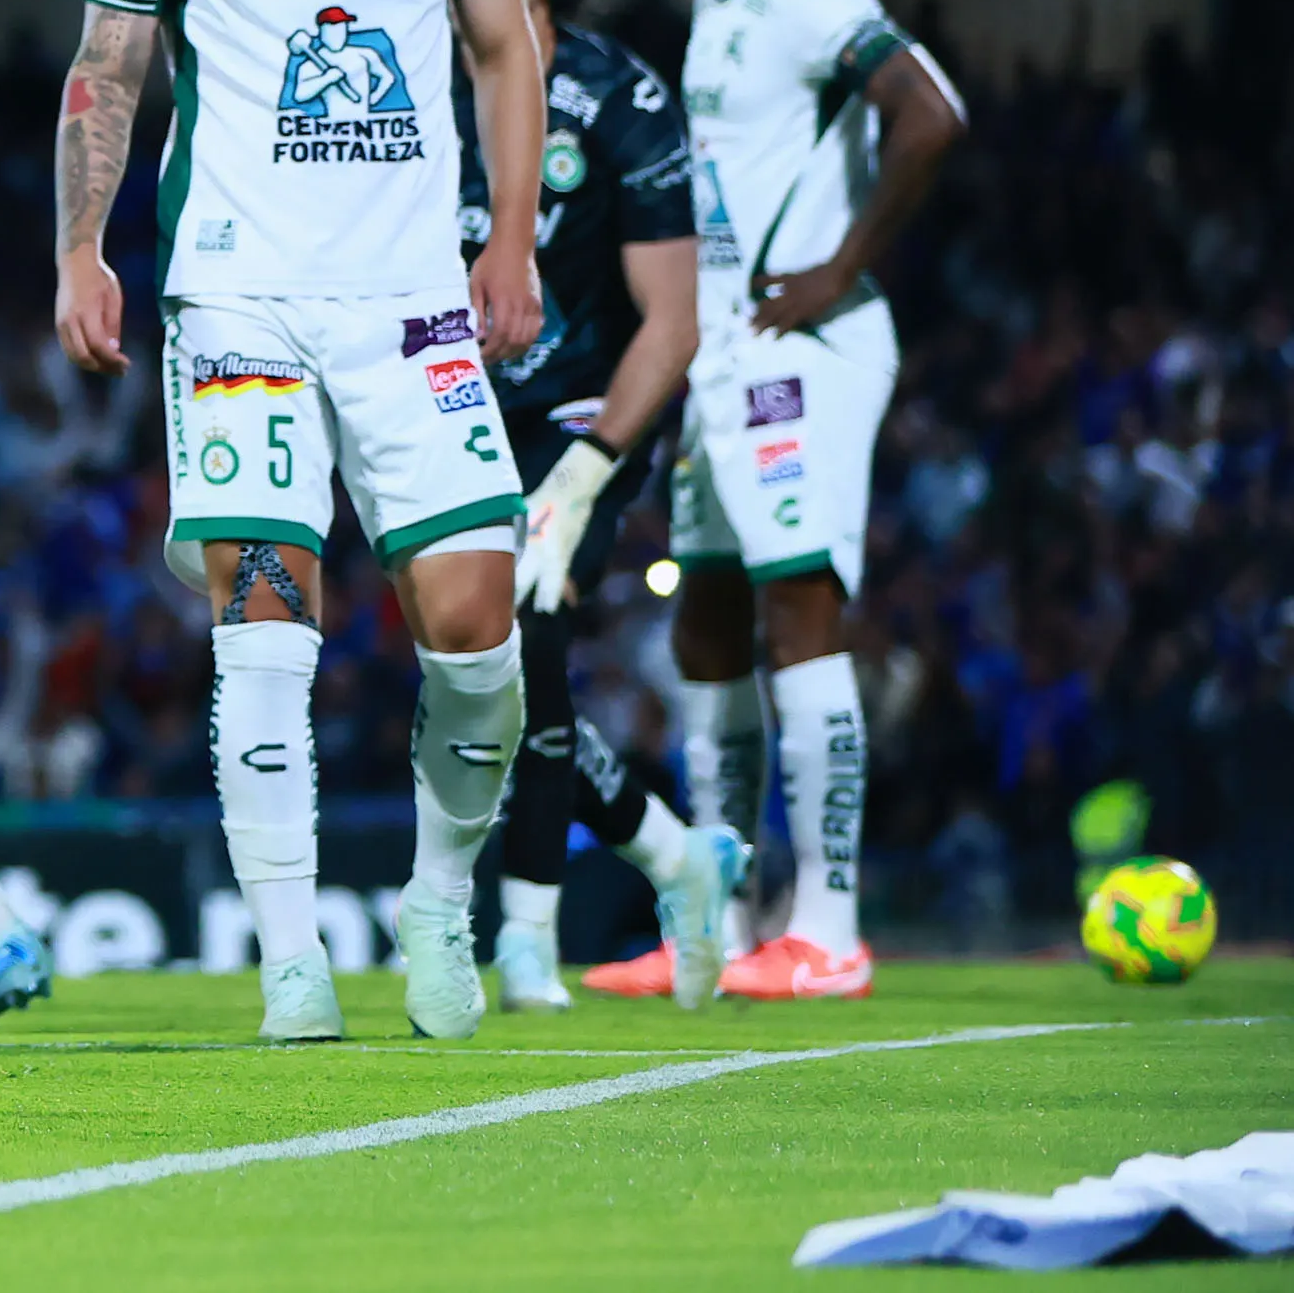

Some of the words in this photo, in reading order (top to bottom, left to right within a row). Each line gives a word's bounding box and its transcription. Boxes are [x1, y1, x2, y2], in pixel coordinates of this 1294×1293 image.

[277, 115, 419, 139] CEMENTOS
[273, 140, 425, 163] FORTALEZA
[268, 414, 294, 489] 5
